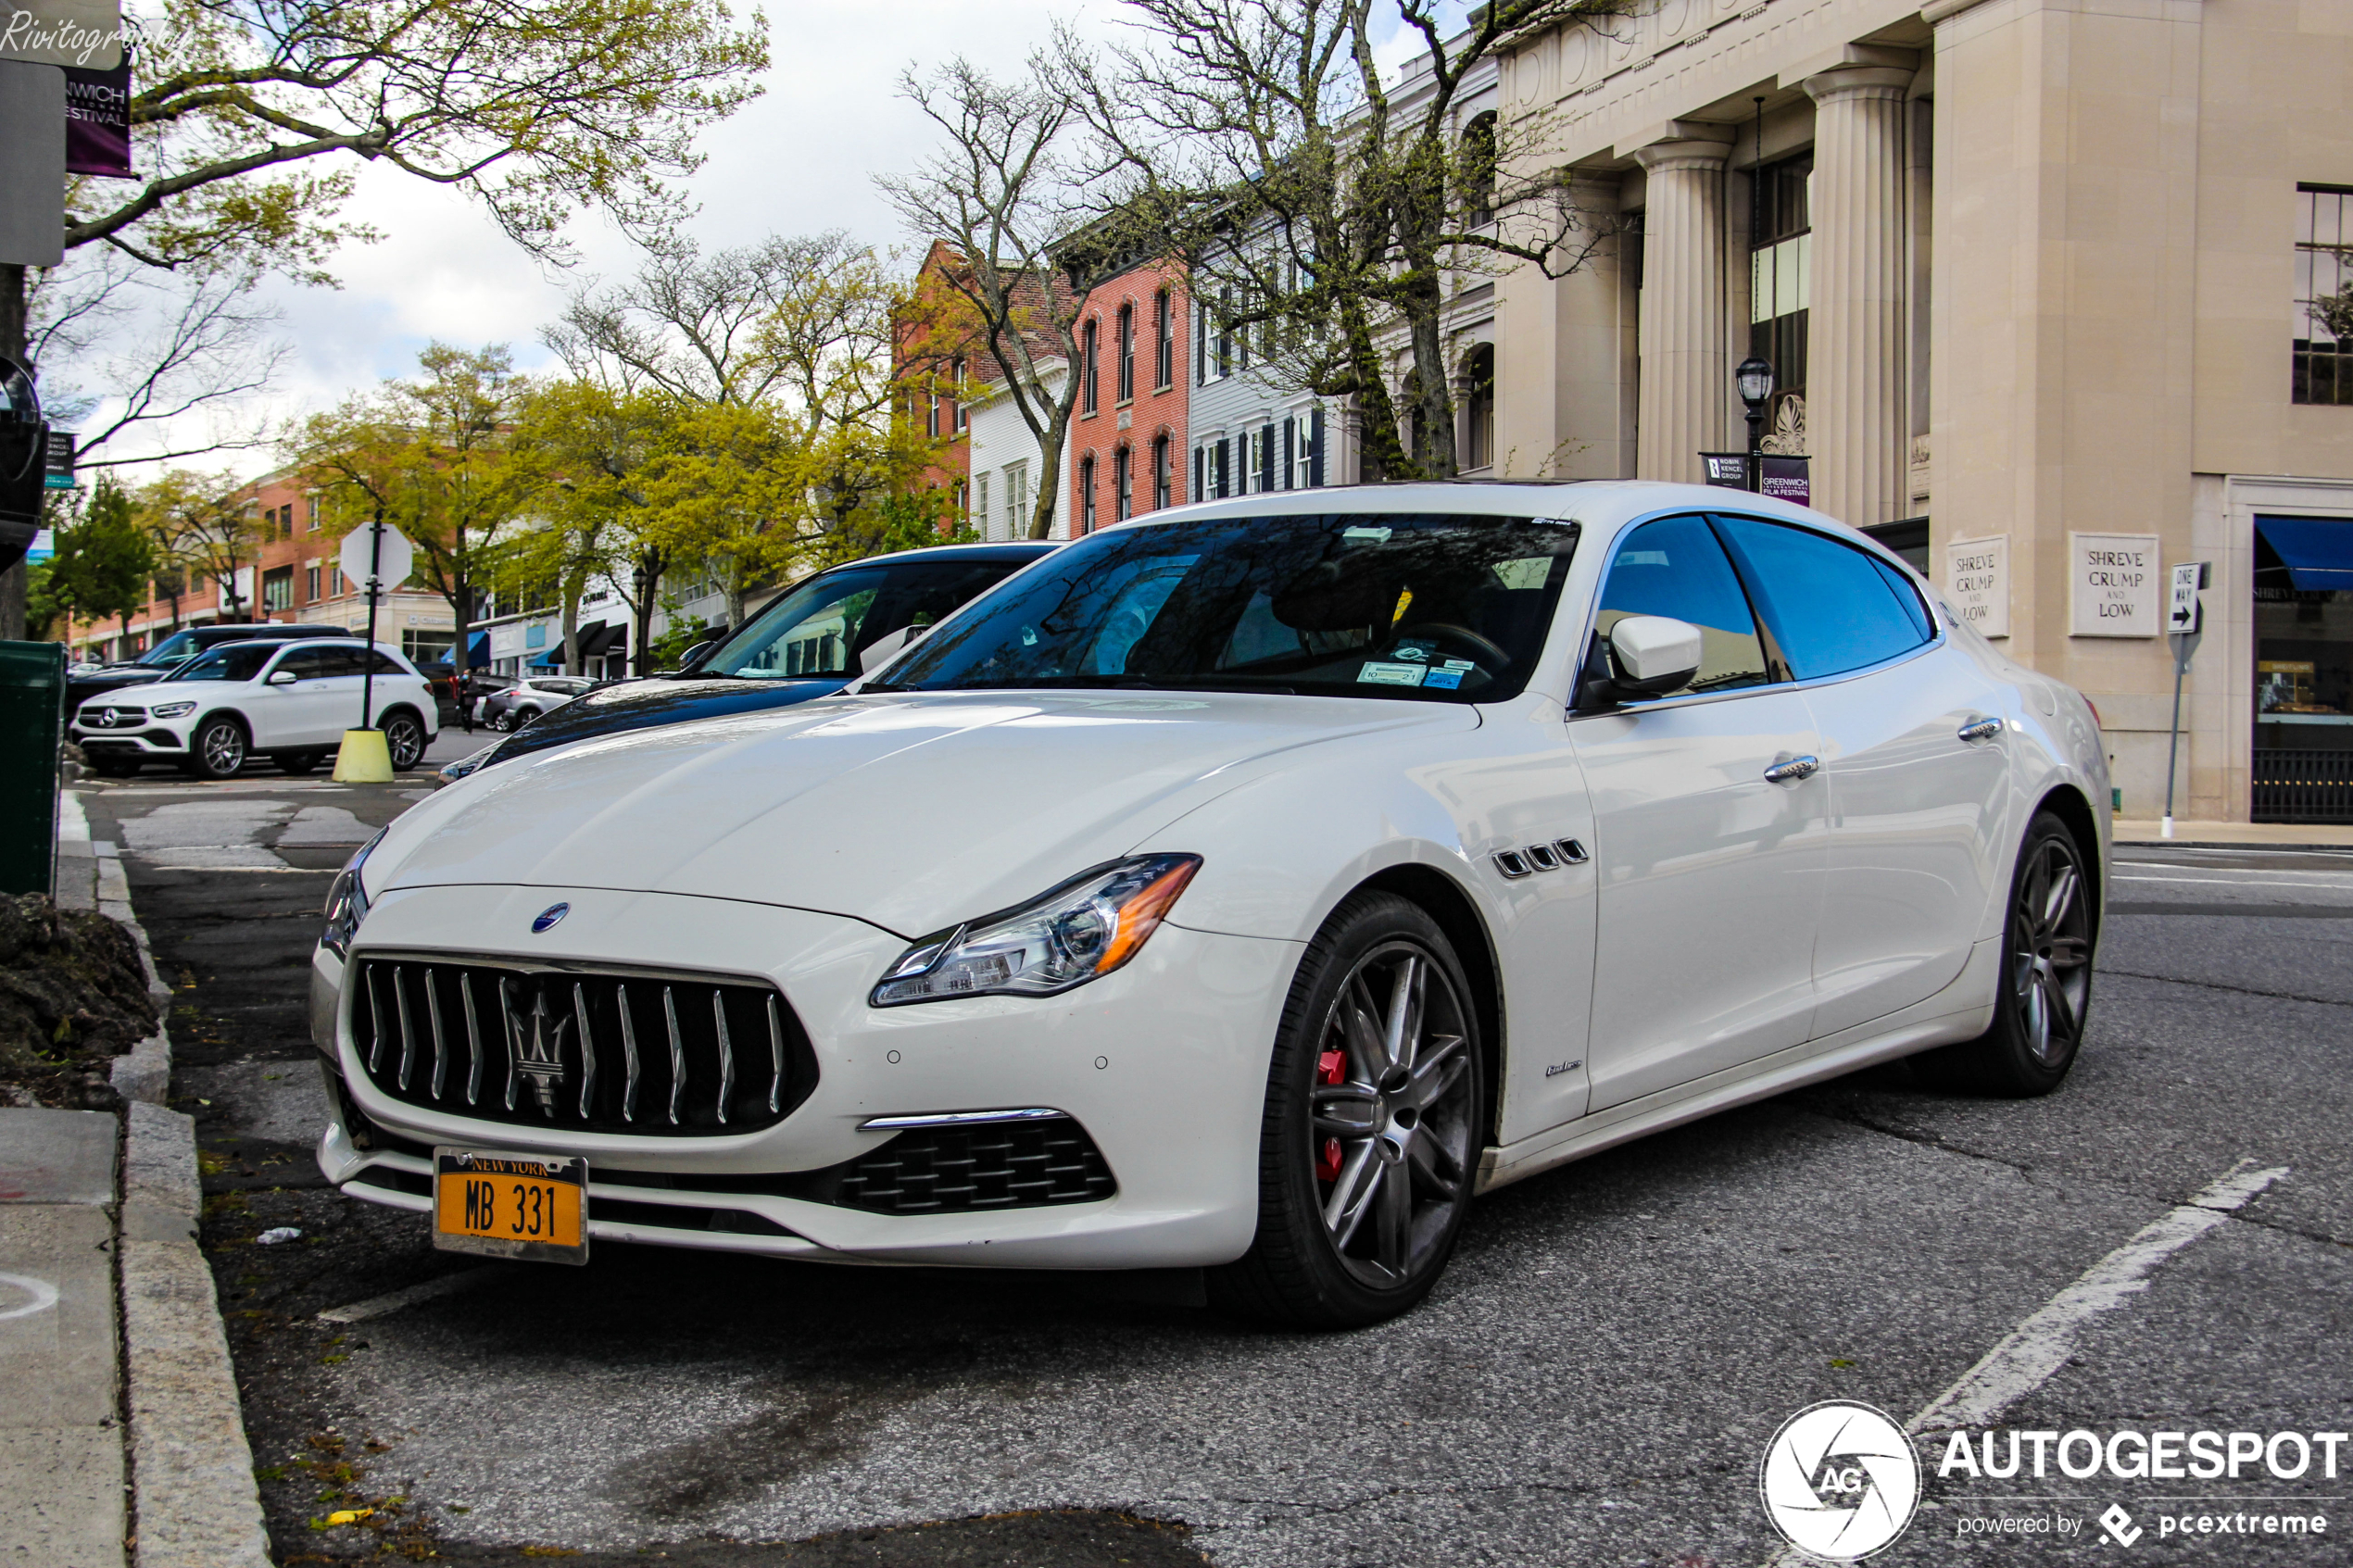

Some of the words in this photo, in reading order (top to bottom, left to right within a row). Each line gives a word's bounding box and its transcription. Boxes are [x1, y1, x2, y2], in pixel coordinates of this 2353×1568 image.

[1763, 477, 1808, 487] GREENWICH
[1780, 489, 1809, 497] FESTIVAL
[1956, 554, 1995, 572] SHREVE
[2088, 551, 2143, 567] SHREVE
[1957, 574, 1994, 593] CRUMP
[2088, 571, 2144, 587] CRUMP
[2176, 569, 2194, 585] ONE
[2106, 590, 2125, 600] AND
[2175, 587, 2192, 603] WAY
[1963, 605, 1989, 621] LOW
[2099, 603, 2134, 618] LOW
[472, 1159, 506, 1172] NEW
[510, 1160, 548, 1177] YORK
[465, 1180, 495, 1230] MB
[511, 1184, 555, 1236] 331
